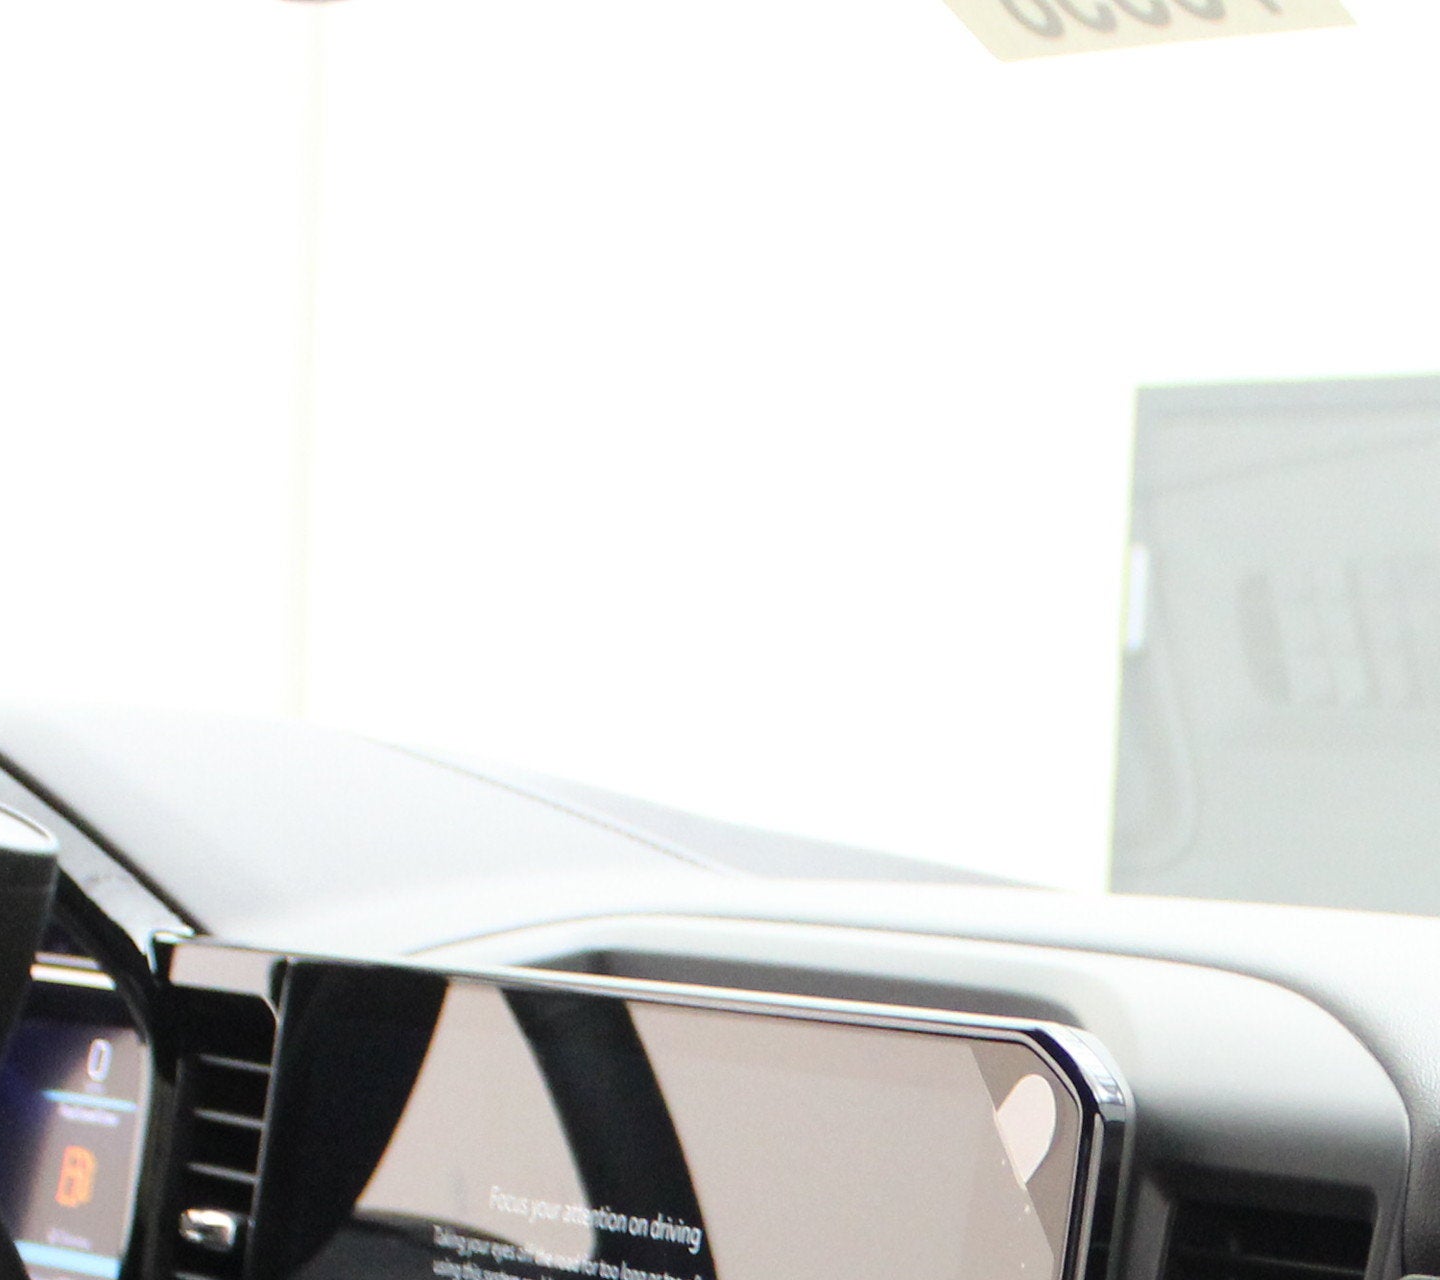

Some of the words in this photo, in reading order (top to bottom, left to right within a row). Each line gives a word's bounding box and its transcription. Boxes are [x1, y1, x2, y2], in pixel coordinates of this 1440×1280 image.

[628, 1215, 650, 1238] on
[650, 1212, 703, 1255] driving
[599, 1259, 620, 1280] too
